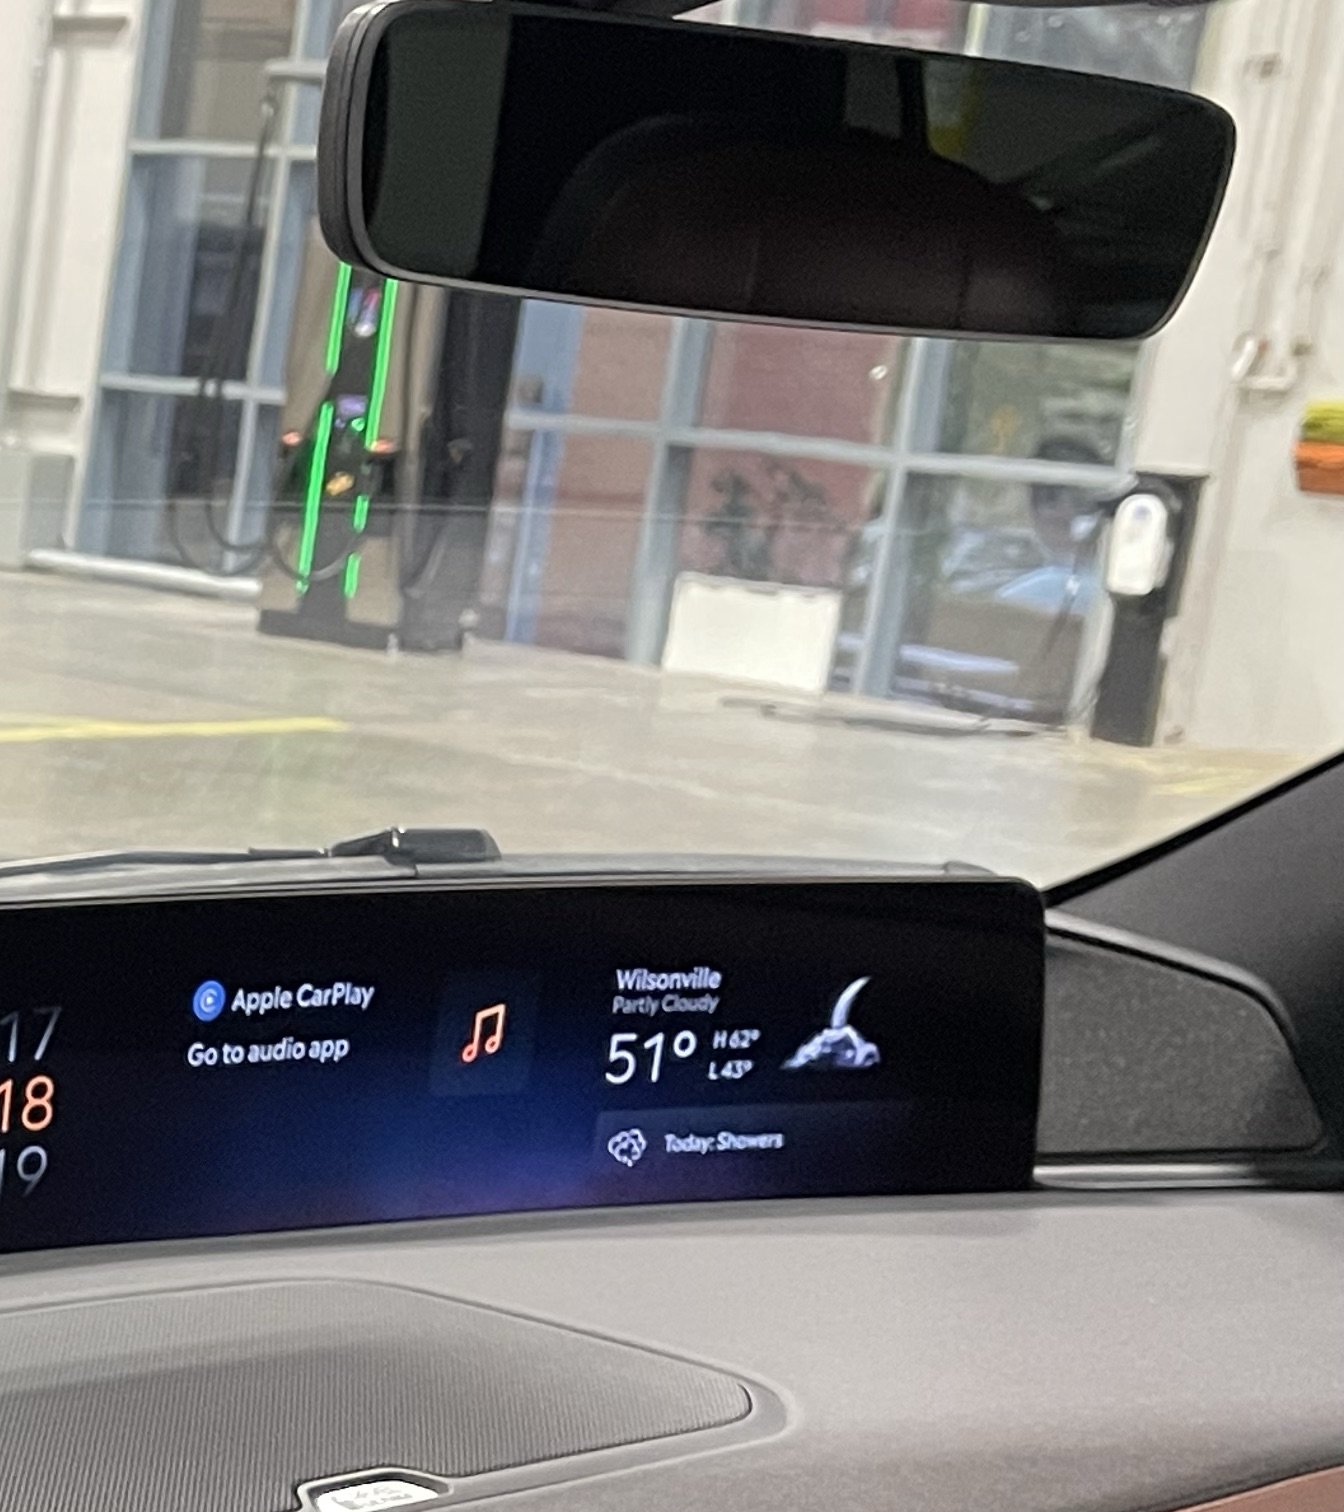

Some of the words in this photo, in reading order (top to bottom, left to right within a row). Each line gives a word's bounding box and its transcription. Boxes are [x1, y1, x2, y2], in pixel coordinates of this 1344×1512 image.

[616, 967, 722, 990] Wilsonville
[231, 985, 293, 1016] Apple
[296, 982, 375, 1010] CarPlay
[612, 995, 659, 1016] Partly
[662, 993, 720, 1014] Cloudy
[0, 1006, 62, 1063] 17
[713, 1030, 727, 1050] H
[187, 1042, 218, 1067] Go
[222, 1041, 244, 1063] to
[247, 1036, 305, 1062] audio
[308, 1038, 350, 1063] app
[605, 1030, 697, 1084] 51°
[716, 1131, 785, 1150] Showers
